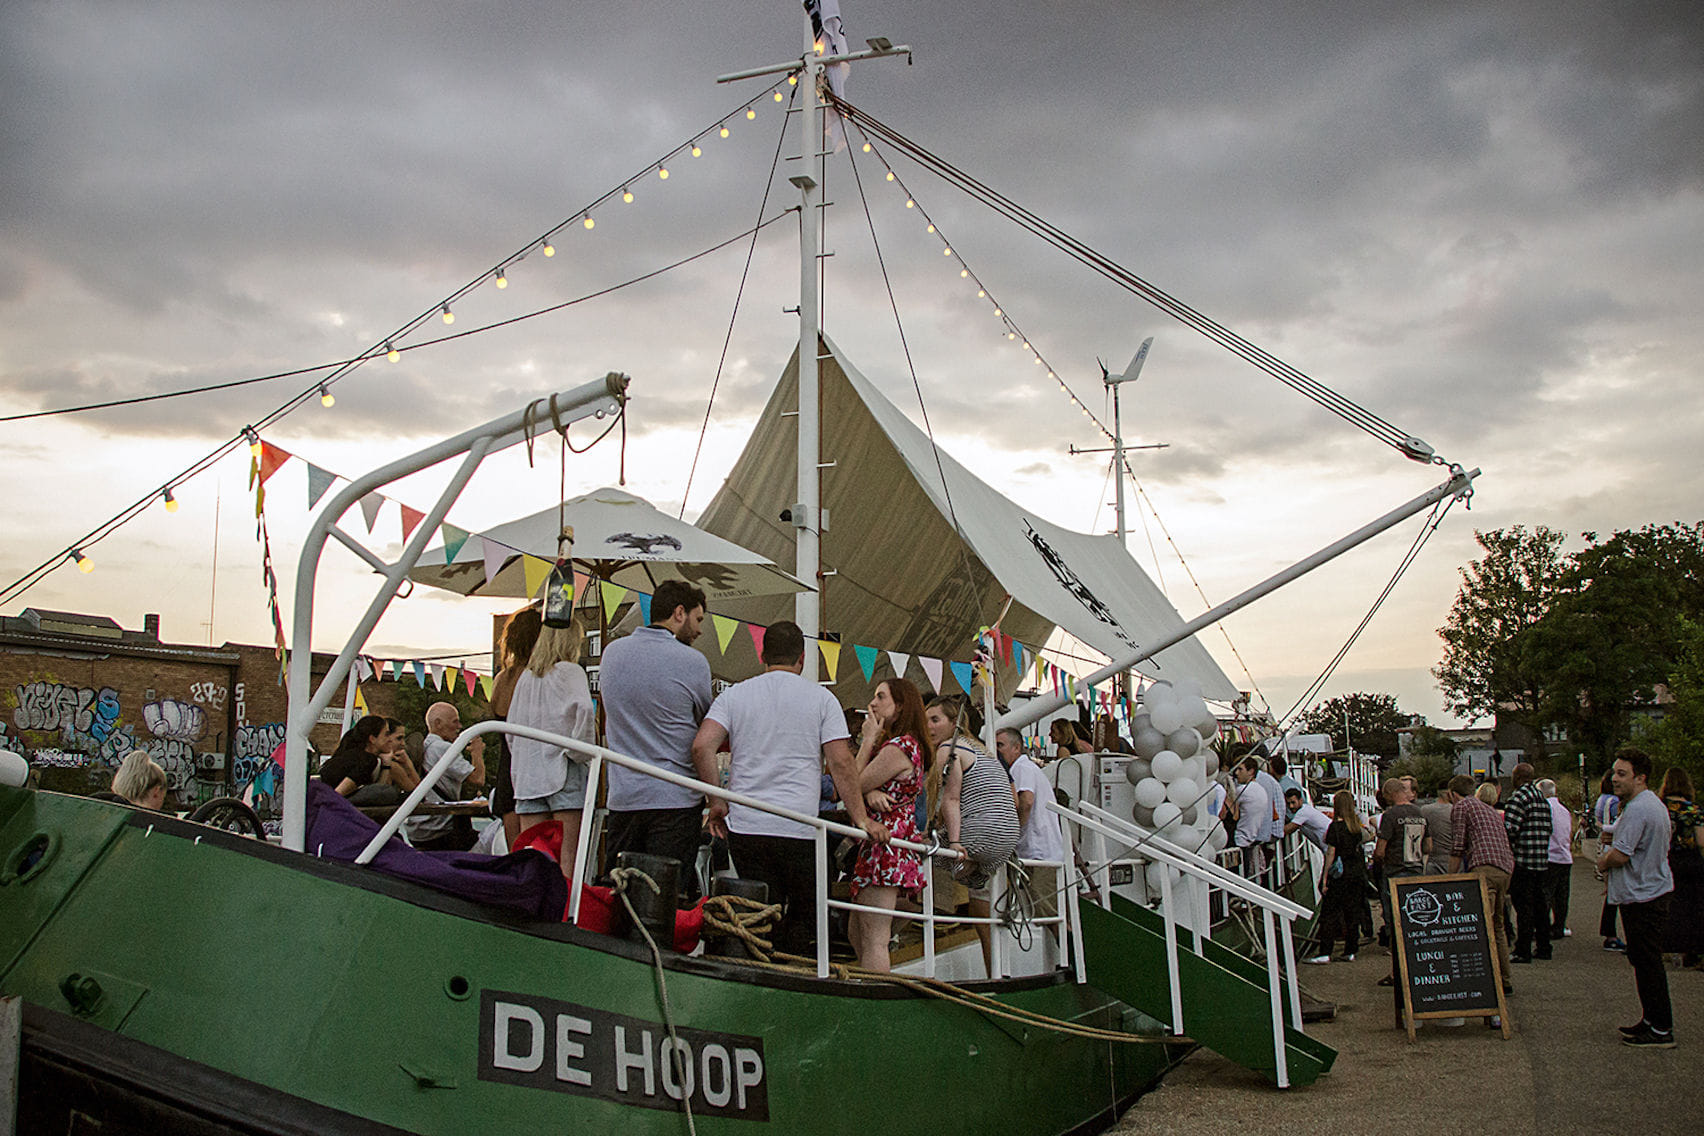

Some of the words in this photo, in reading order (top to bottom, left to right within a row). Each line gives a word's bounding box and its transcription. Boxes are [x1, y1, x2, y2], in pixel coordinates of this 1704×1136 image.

[1442, 913, 1479, 925] KITCHEN
[1415, 951, 1445, 962] LUNCH
[1414, 974, 1451, 985] DINNER
[493, 1001, 592, 1087] DE
[614, 1025, 763, 1111] HOOP
